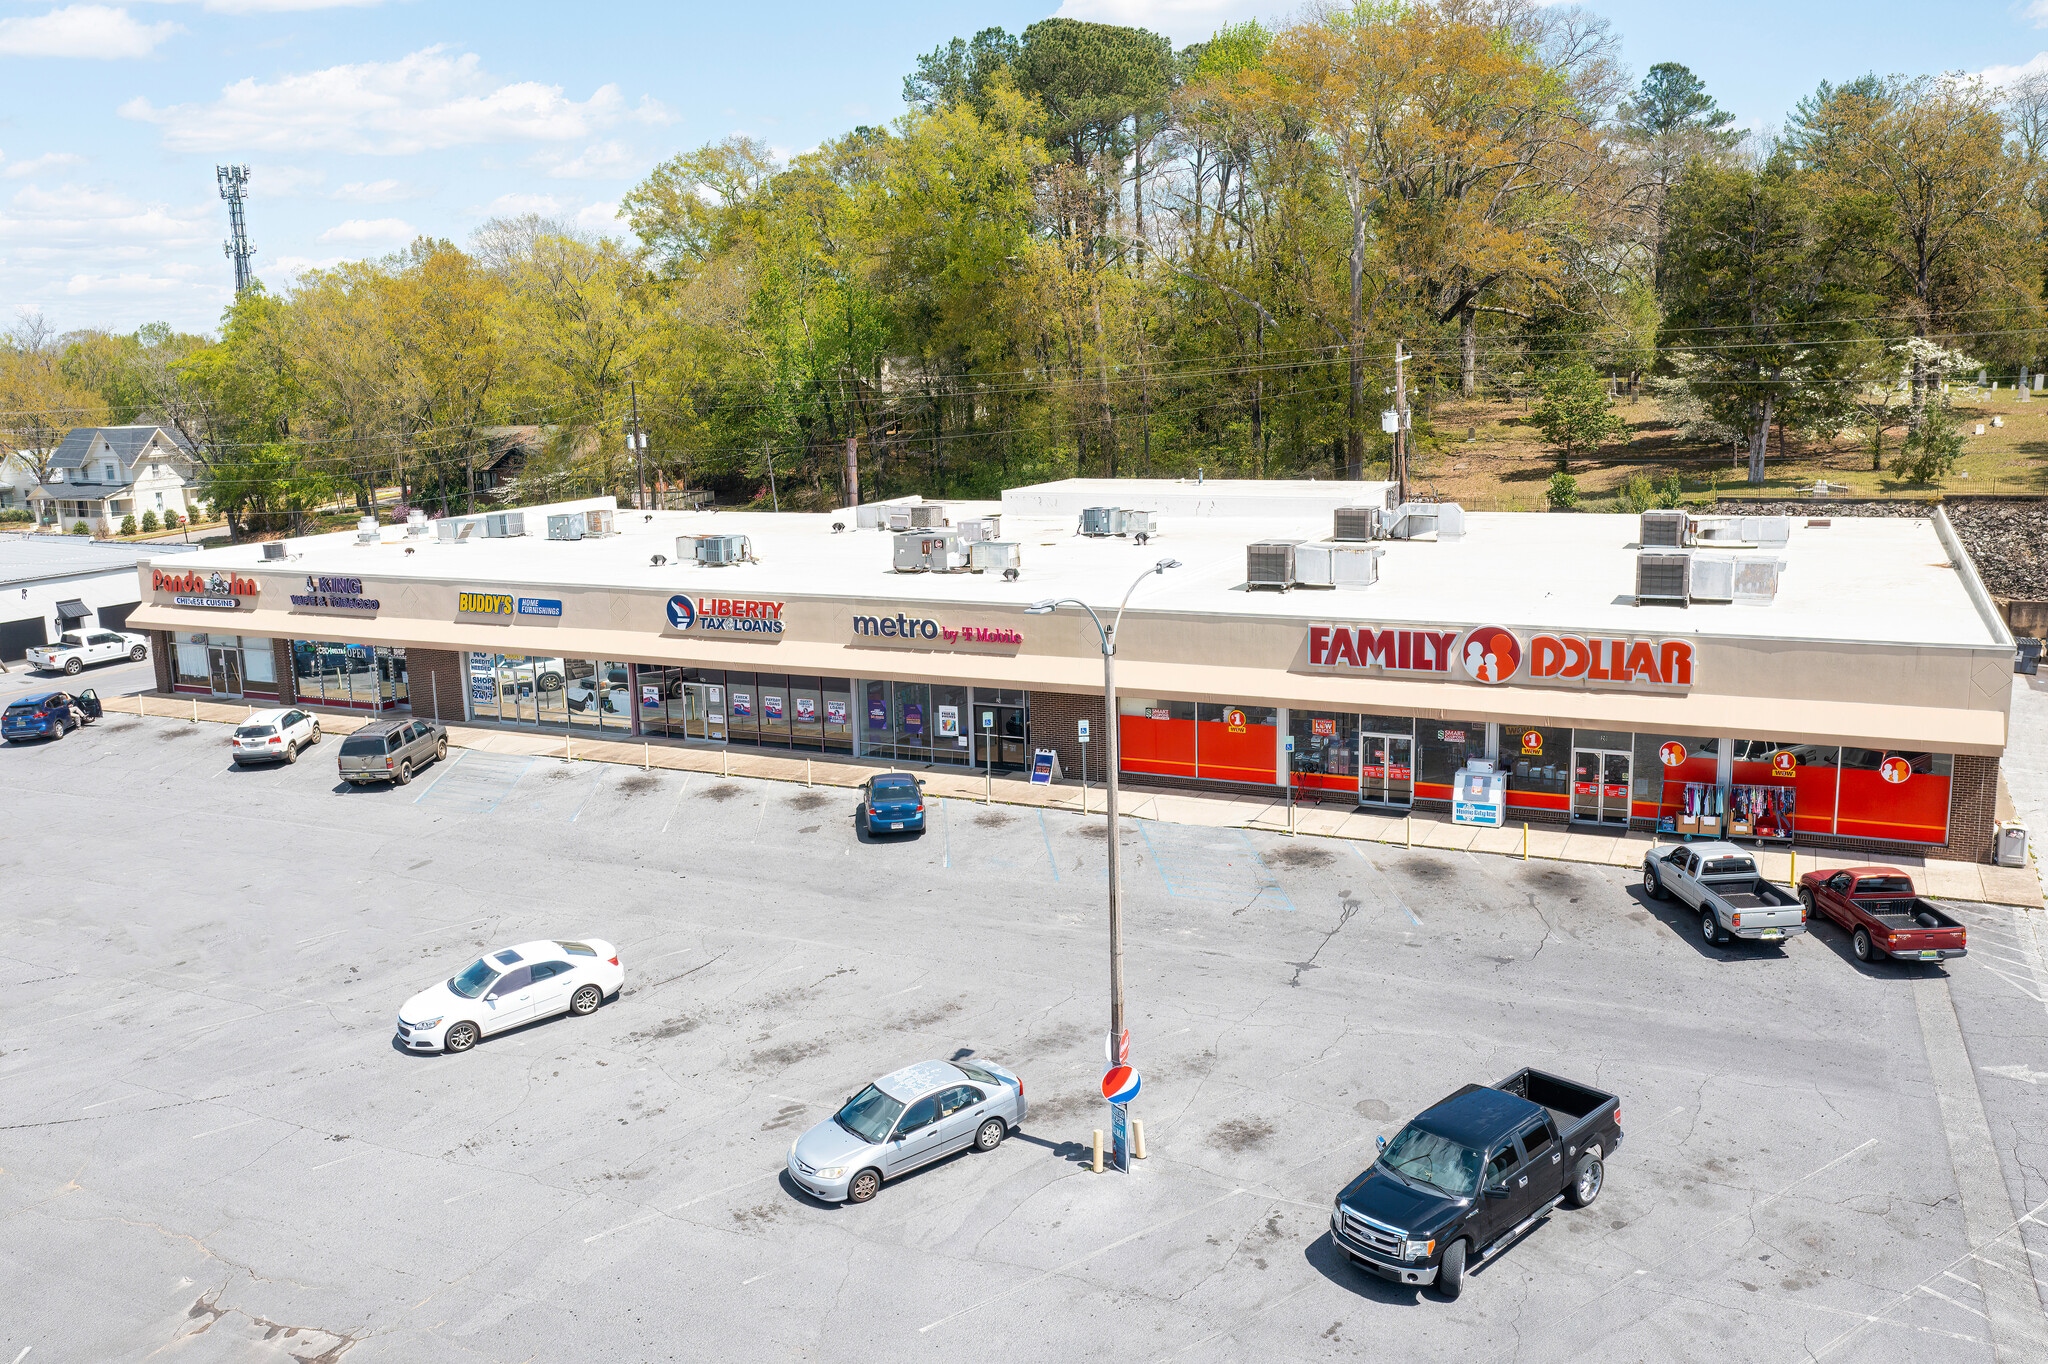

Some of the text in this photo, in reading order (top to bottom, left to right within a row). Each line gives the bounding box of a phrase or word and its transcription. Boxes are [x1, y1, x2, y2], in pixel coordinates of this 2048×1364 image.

[153, 568, 257, 596] Panda Inn
[318, 577, 362, 594] KING
[176, 597, 233, 608] CHINESE CUISINE
[290, 595, 379, 610] VAPE & TOBACCO
[459, 592, 514, 615] BUDDY'S
[521, 599, 539, 607] HOME
[521, 606, 560, 616] FURNISHINGS
[698, 598, 785, 619] LIBERTY
[699, 617, 725, 630] TAX
[733, 619, 785, 634] LOANS
[853, 613, 939, 640] metro
[942, 626, 959, 645] by
[346, 648, 367, 659] OPEN
[1309, 626, 1456, 671] FAMILY
[1530, 635, 1693, 685] DOLLAR
[1525, 733, 1537, 746] $1
[1777, 754, 1790, 768] $1
